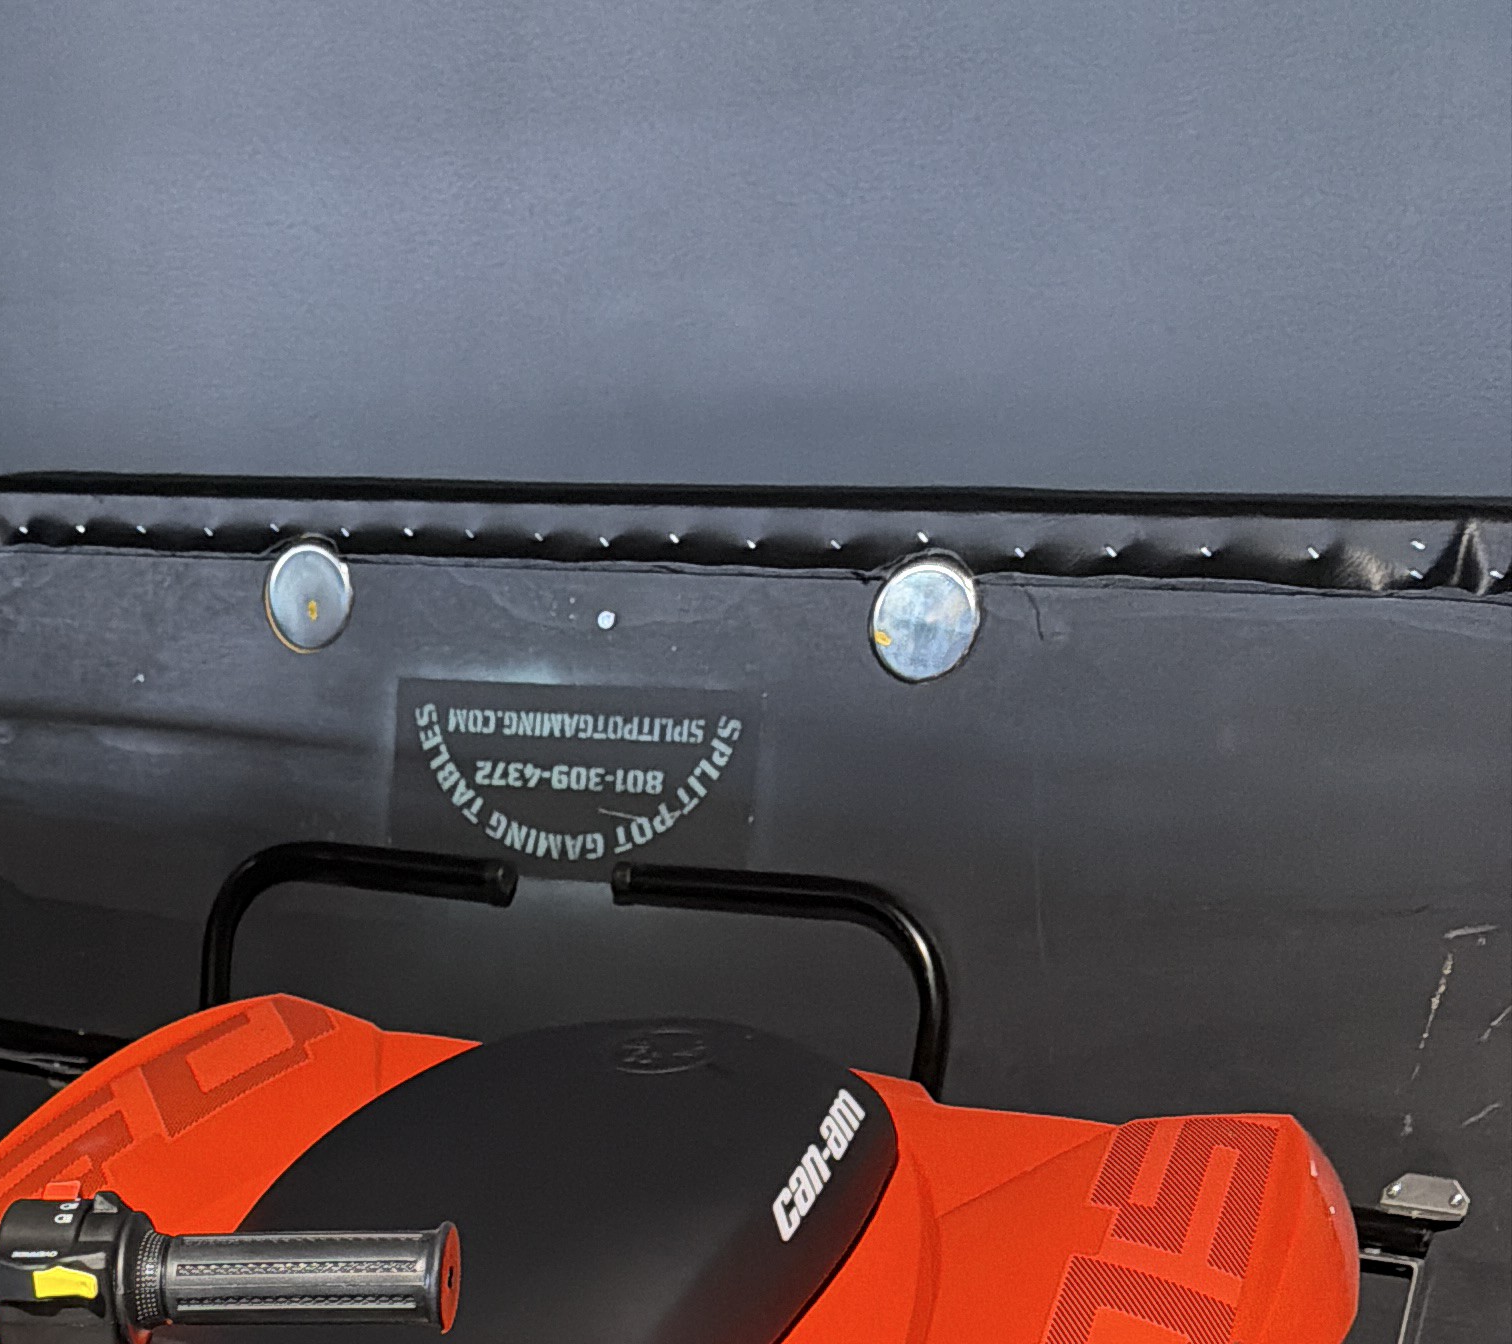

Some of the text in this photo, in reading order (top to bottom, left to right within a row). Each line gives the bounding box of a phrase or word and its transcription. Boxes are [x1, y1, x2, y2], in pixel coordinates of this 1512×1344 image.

[447, 707, 705, 743] SPLITPOTGAMING.COM
[415, 702, 742, 860] SPLIT POT GAMING TABLES
[474, 760, 664, 795] 801-309-4372
[772, 1088, 866, 1242] can-am
